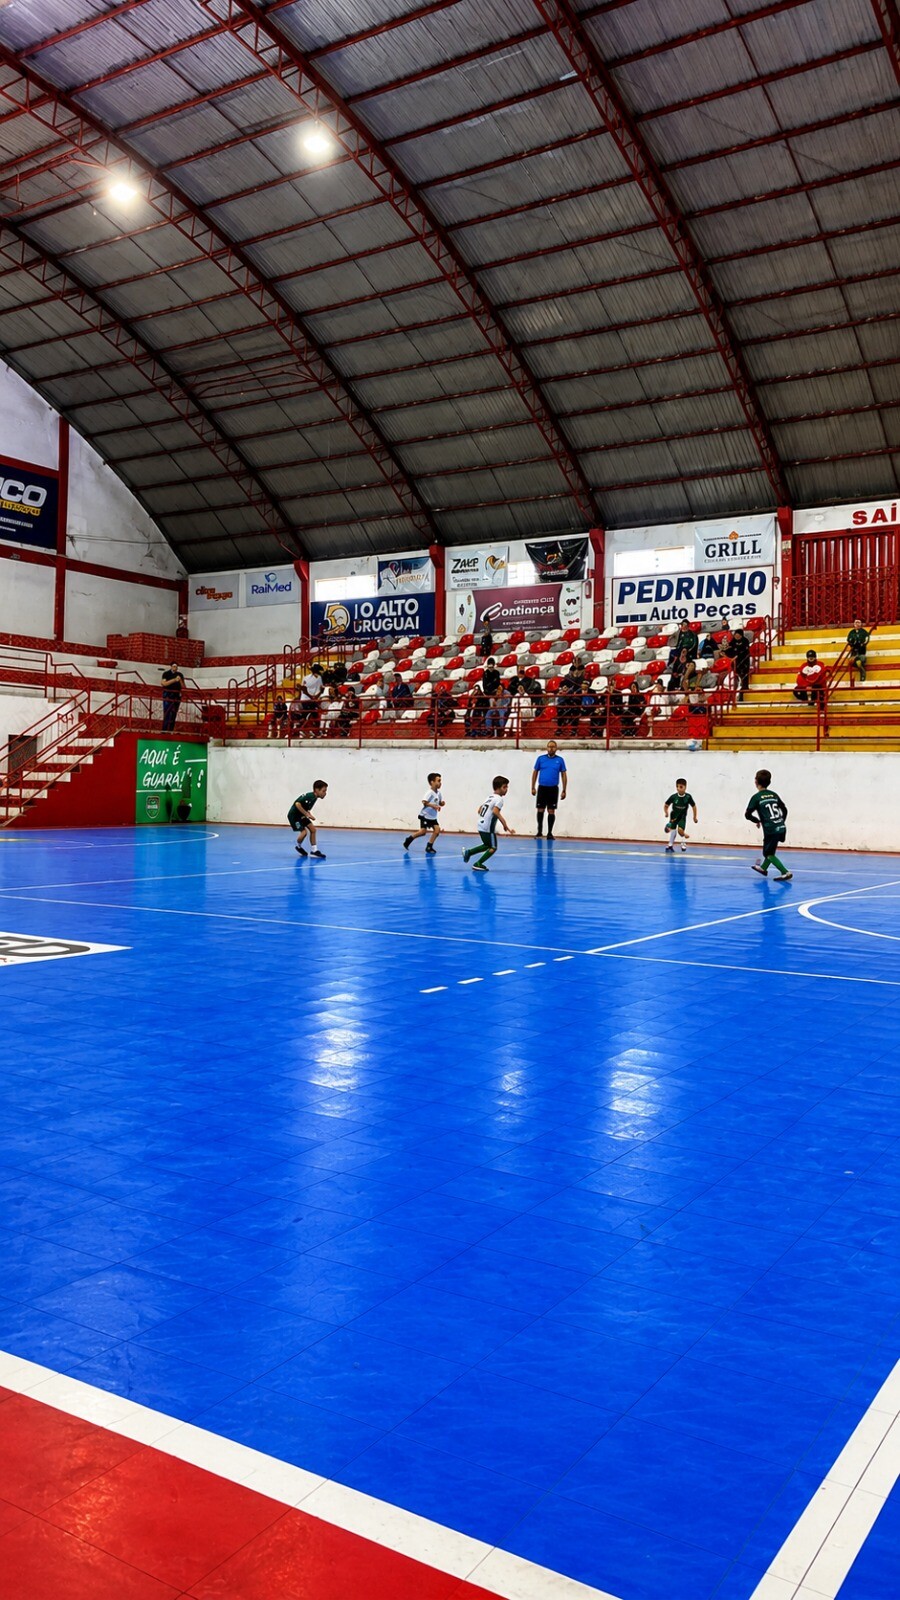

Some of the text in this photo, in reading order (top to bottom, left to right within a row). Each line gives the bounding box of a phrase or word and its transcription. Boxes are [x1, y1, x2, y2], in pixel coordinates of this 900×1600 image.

[705, 540, 762, 558] GRILL
[251, 582, 292, 595] RaiMed
[617, 570, 767, 605] PEDRINHO
[376, 598, 419, 617] ALTO
[650, 602, 757, 621] Auto Peças
[353, 616, 420, 633] URUGUAI
